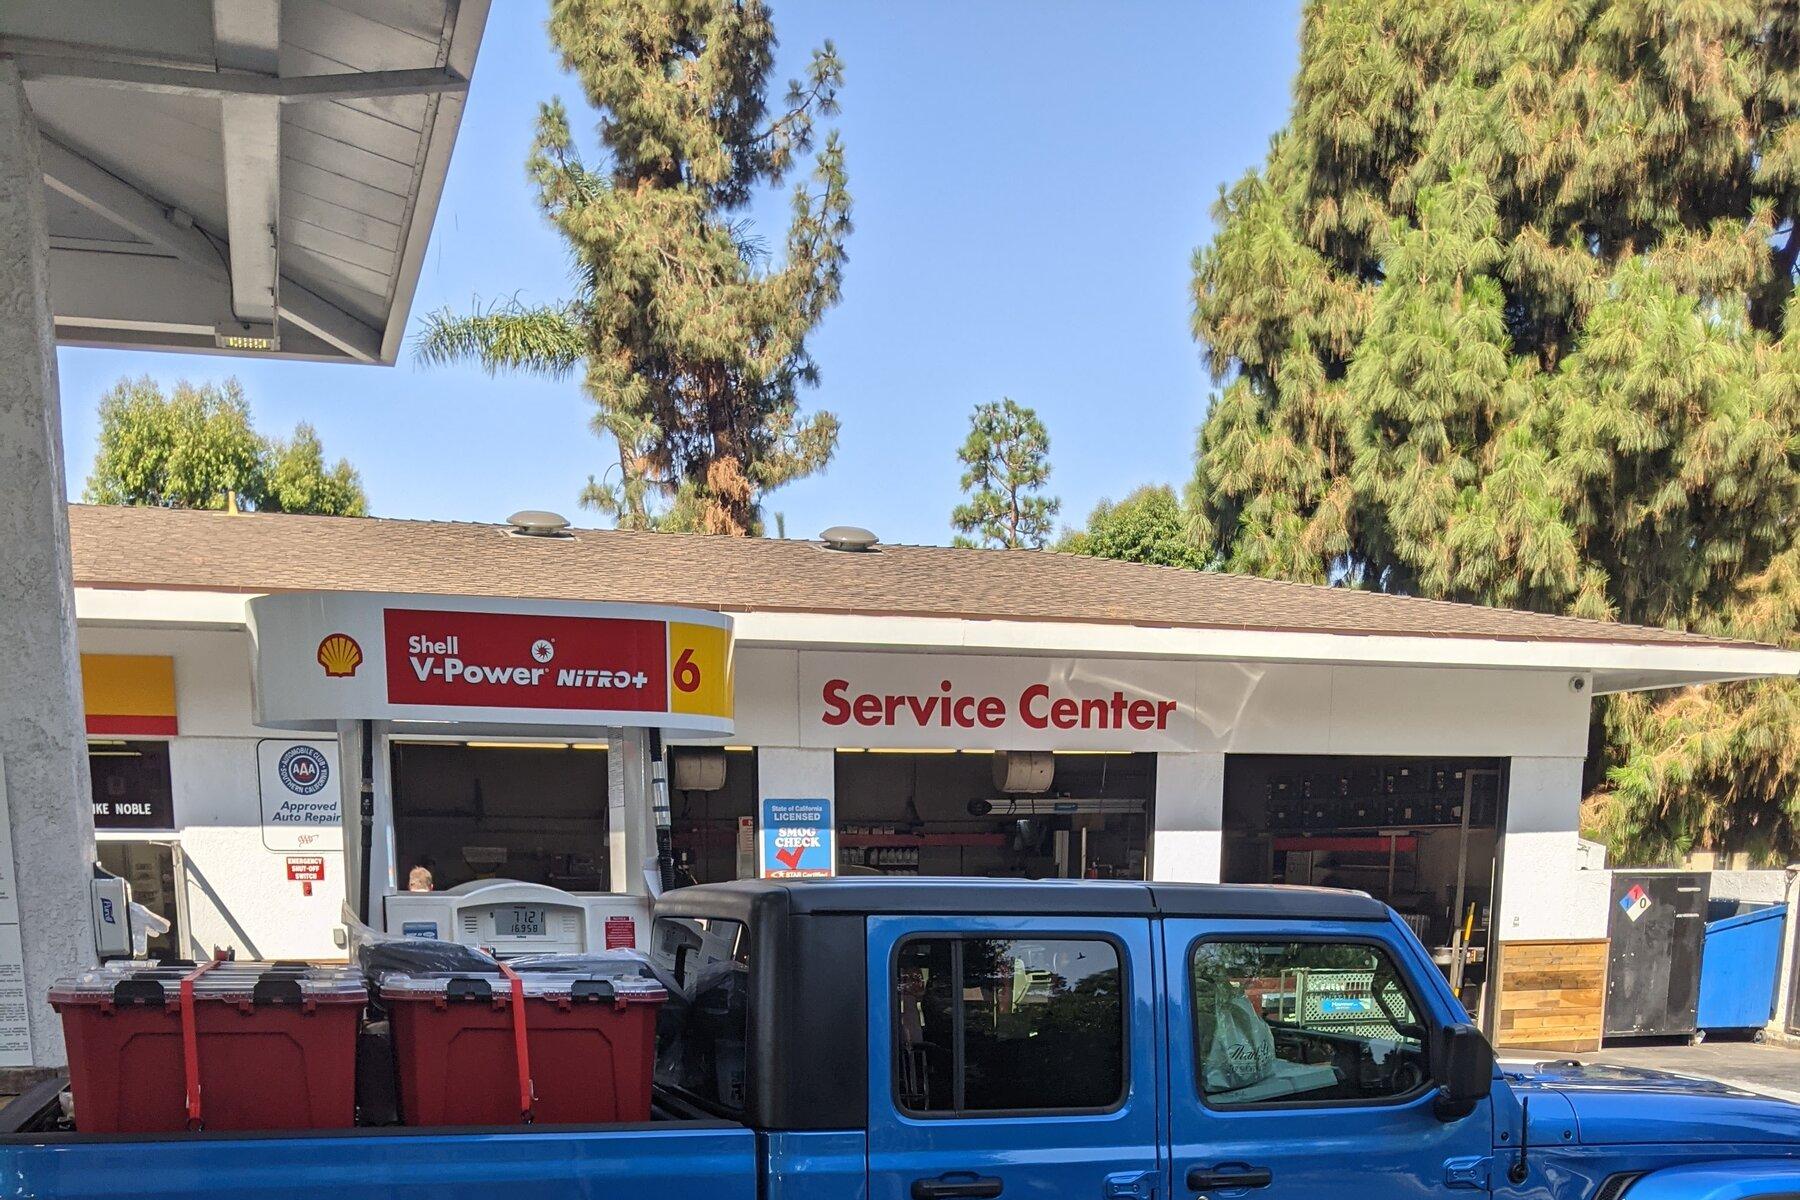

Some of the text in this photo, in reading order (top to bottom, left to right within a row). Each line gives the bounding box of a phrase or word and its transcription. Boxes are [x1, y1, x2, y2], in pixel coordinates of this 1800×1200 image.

[408, 634, 459, 655] Shell
[409, 656, 545, 686] V-Power
[672, 648, 701, 693] 6
[821, 678, 1177, 731] Service Center
[312, 751, 327, 767] CLUB
[292, 762, 316, 776] AAA
[280, 768, 304, 794] SOUTHERN
[115, 803, 152, 815] NOBLE
[280, 800, 337, 813] Approved
[272, 812, 342, 825] Auto Repair
[773, 812, 821, 821] LICENSED
[778, 827, 817, 837] SMOG
[774, 837, 821, 848] CHECK
[1639, 897, 1647, 909] 0
